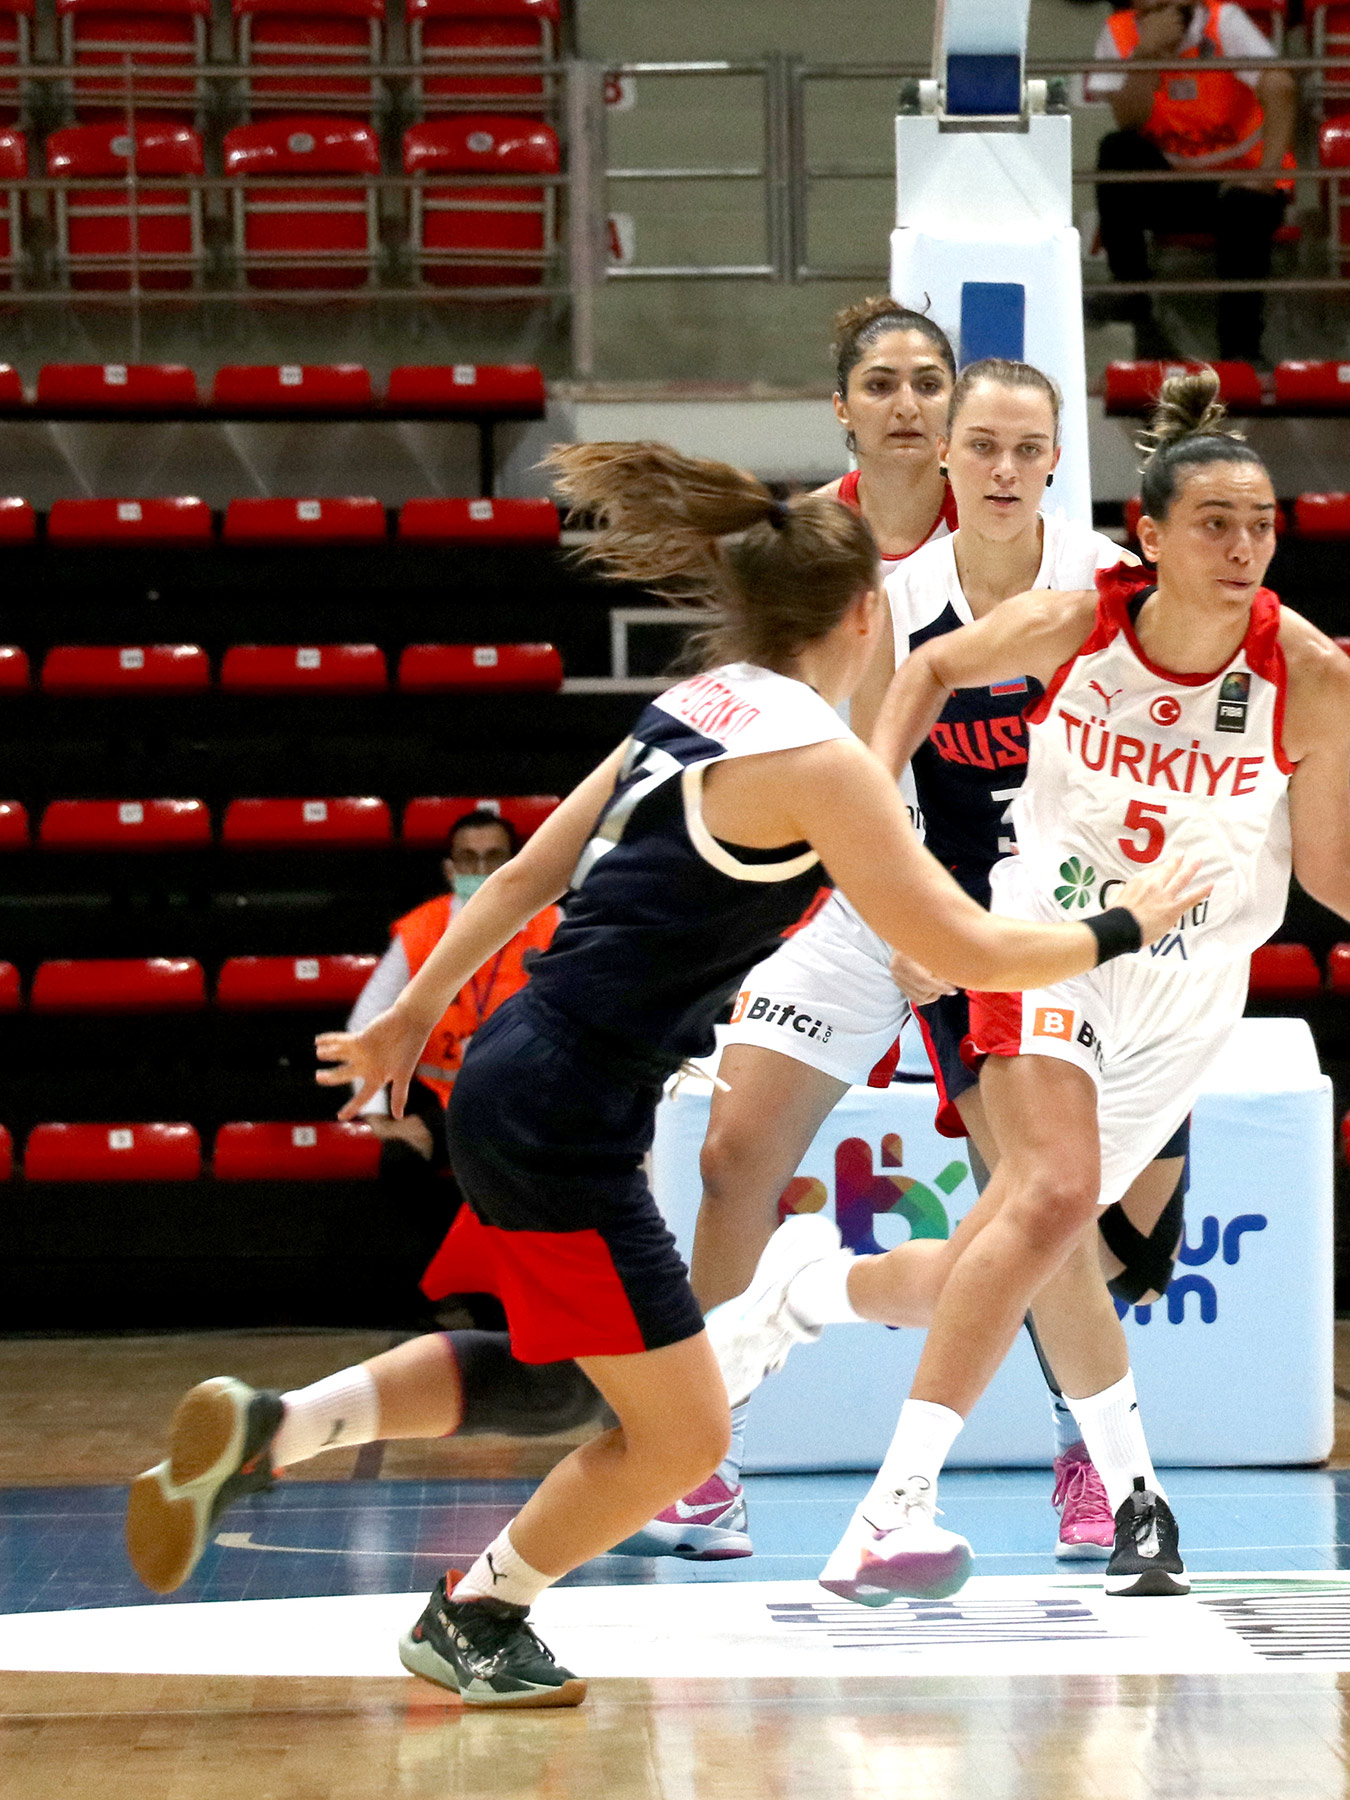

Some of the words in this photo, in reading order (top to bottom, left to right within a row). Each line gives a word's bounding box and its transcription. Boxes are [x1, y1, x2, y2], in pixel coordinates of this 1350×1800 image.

[929, 715, 1029, 771] RUS
[1058, 709, 1265, 797] TÜRKİYE
[1117, 799, 1168, 864] 5
[747, 997, 822, 1038] Bitci
